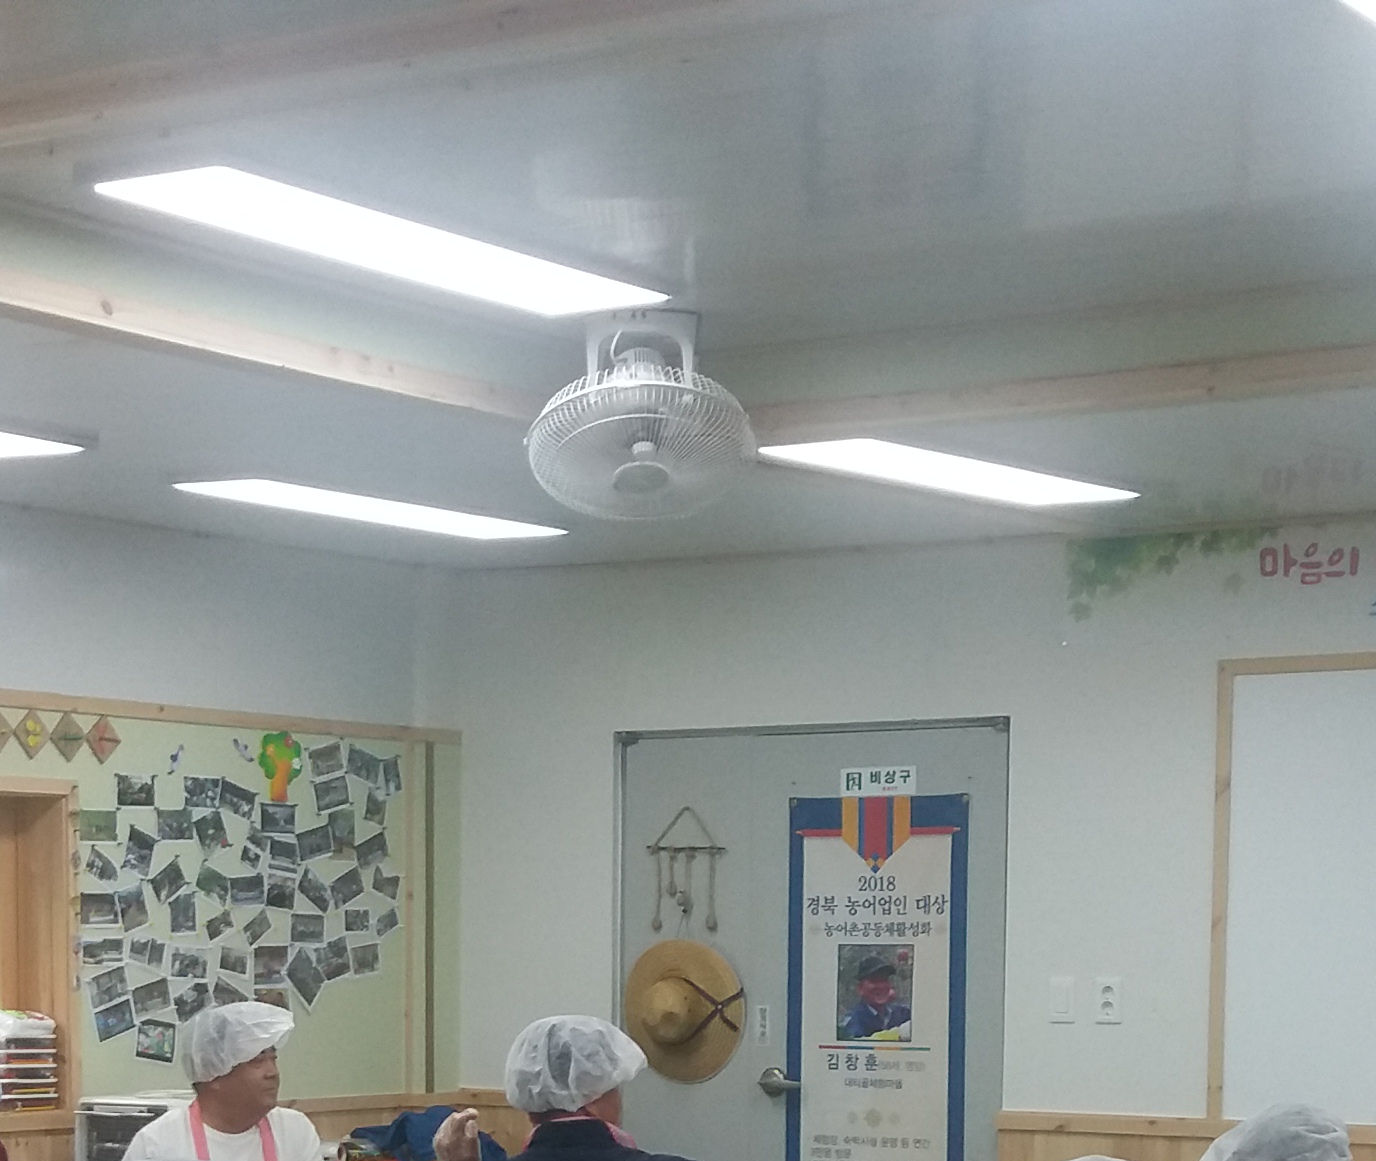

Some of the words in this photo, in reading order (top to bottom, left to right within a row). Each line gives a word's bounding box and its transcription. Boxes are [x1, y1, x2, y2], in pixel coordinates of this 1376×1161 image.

[1259, 542, 1360, 585] 마음의
[869, 769, 911, 785] 비상구
[858, 875, 897, 892] 2018
[806, 895, 838, 916] 경북
[844, 895, 907, 916] 농어업인
[915, 894, 948, 915] 대상
[824, 921, 932, 938] 농어촌공동체활성화
